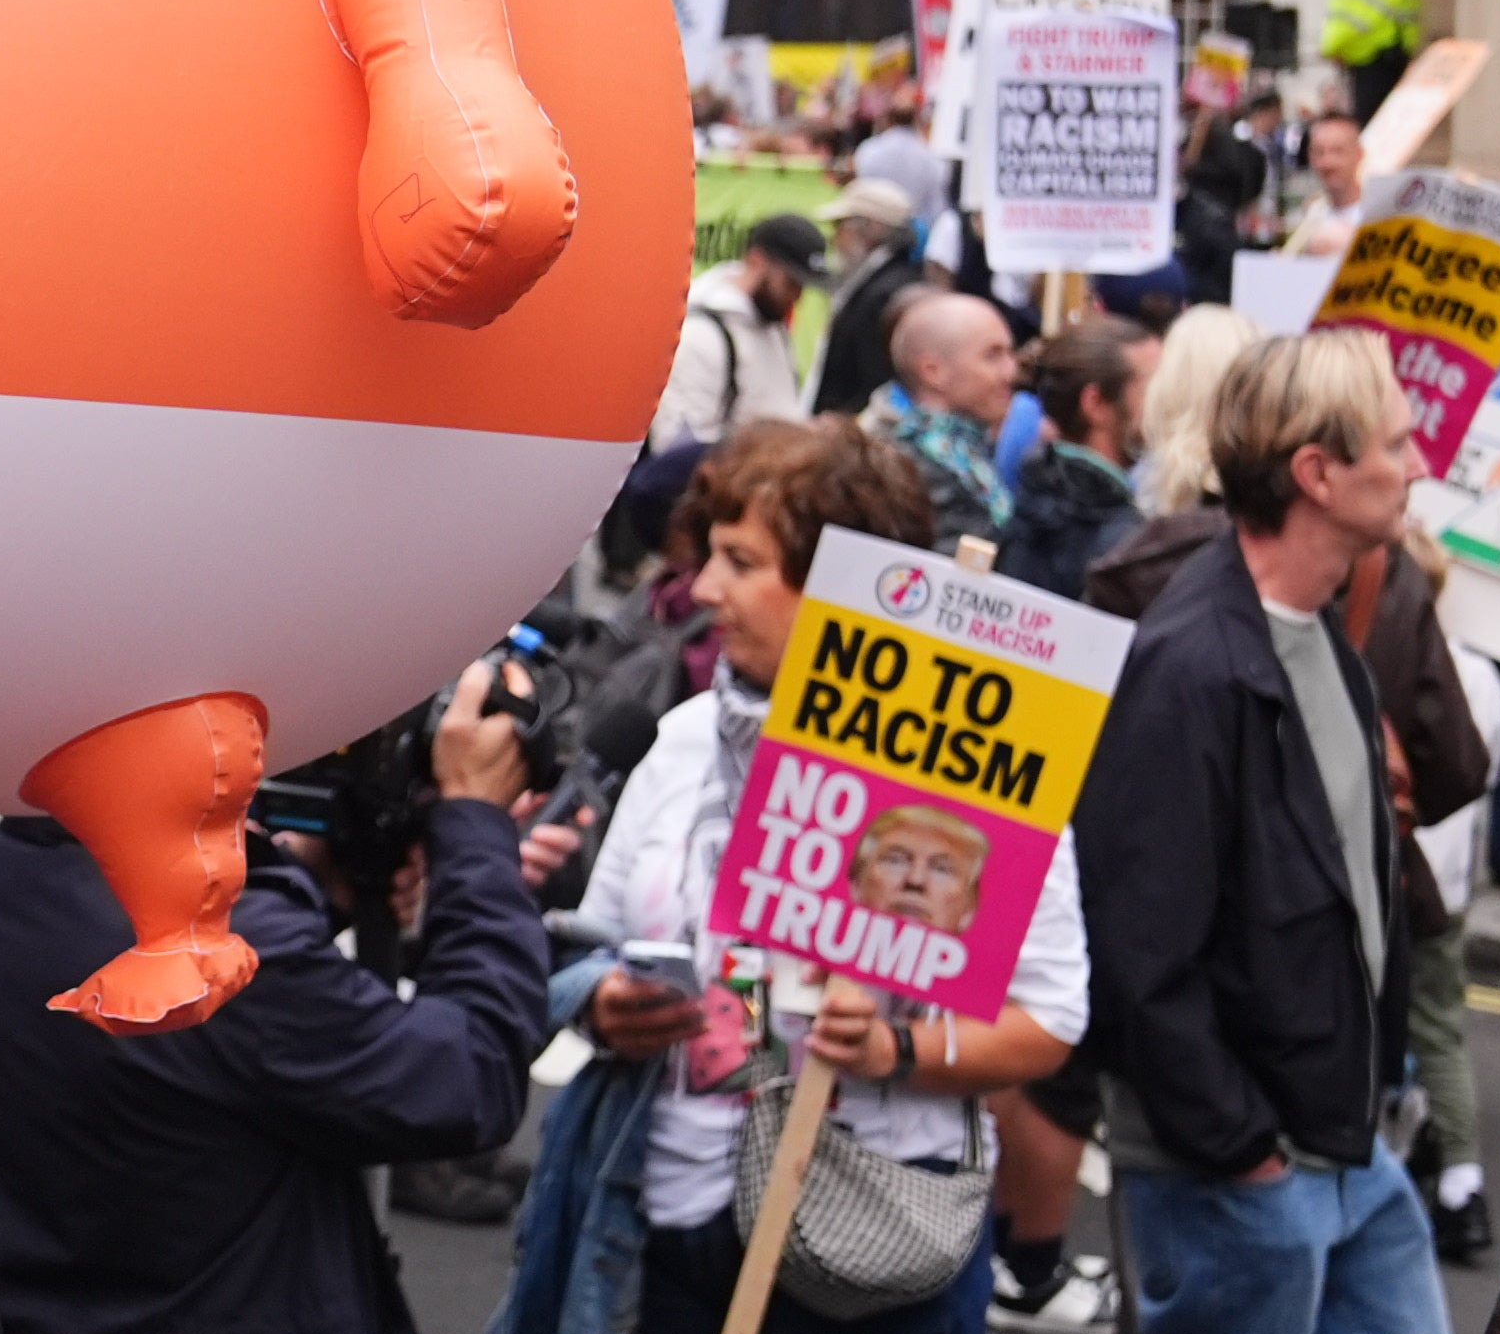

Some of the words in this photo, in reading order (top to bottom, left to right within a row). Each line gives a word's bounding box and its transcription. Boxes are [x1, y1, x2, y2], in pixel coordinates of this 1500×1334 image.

[1001, 86, 1047, 114] NO
[1051, 87, 1090, 114] TO
[1090, 86, 1160, 110] WAR
[1001, 116, 1157, 151] RACISM
[935, 609, 963, 635] TO
[967, 620, 1057, 663] RACISM
[940, 581, 1014, 624] STAND
[1018, 605, 1054, 631] UP
[814, 619, 910, 693] NO
[931, 655, 1013, 729] TO
[793, 678, 1047, 808] RACISM
[764, 754, 869, 835] NO
[758, 813, 844, 891] TO
[739, 868, 969, 992] TRUMP
